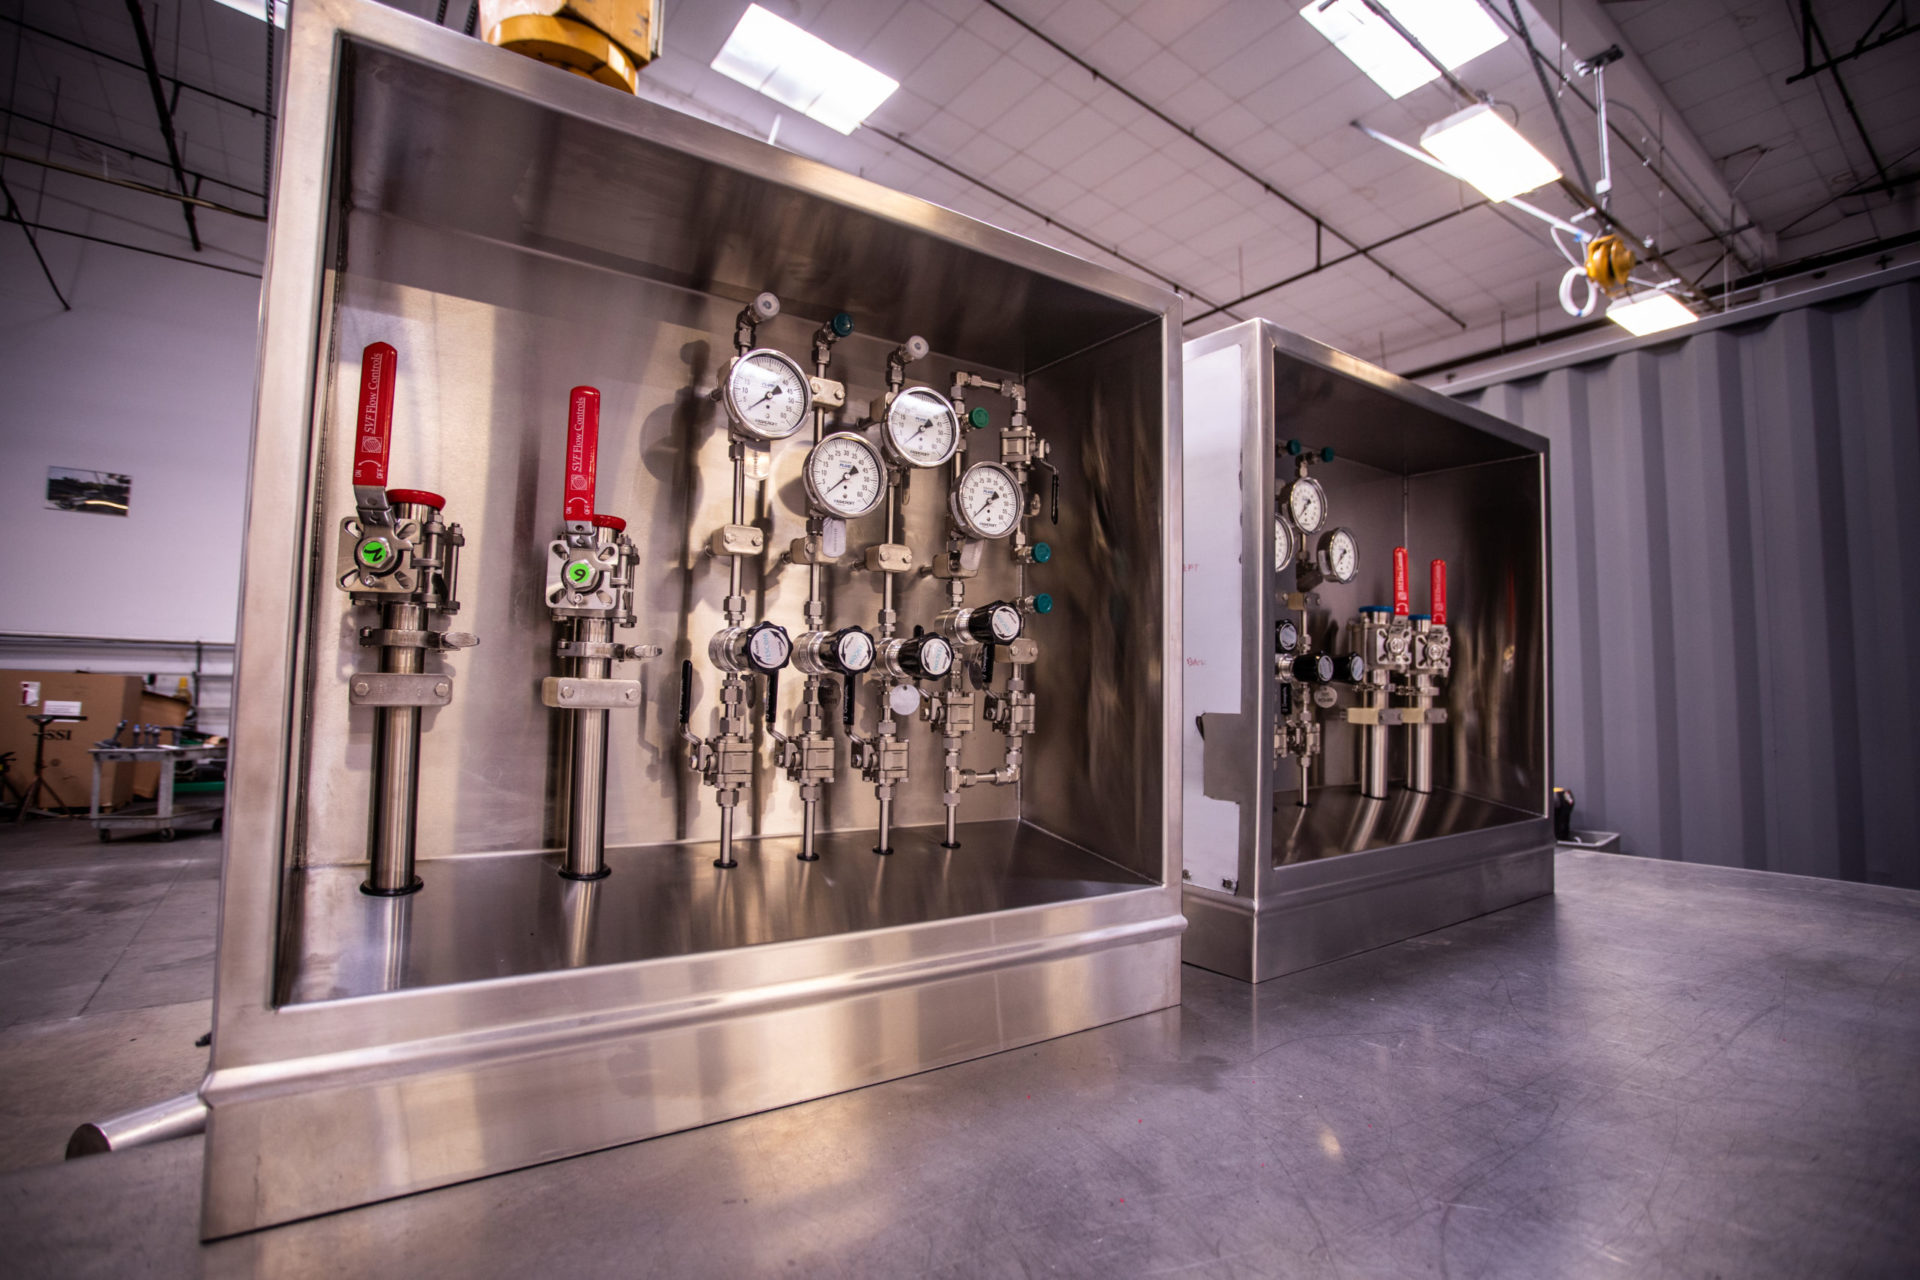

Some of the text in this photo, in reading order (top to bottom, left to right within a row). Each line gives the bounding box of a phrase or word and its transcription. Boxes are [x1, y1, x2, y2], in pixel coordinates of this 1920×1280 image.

[364, 353, 382, 434] SVF Flow Controls
[572, 397, 585, 472] SVF Flow Controls
[355, 469, 362, 478] ON
